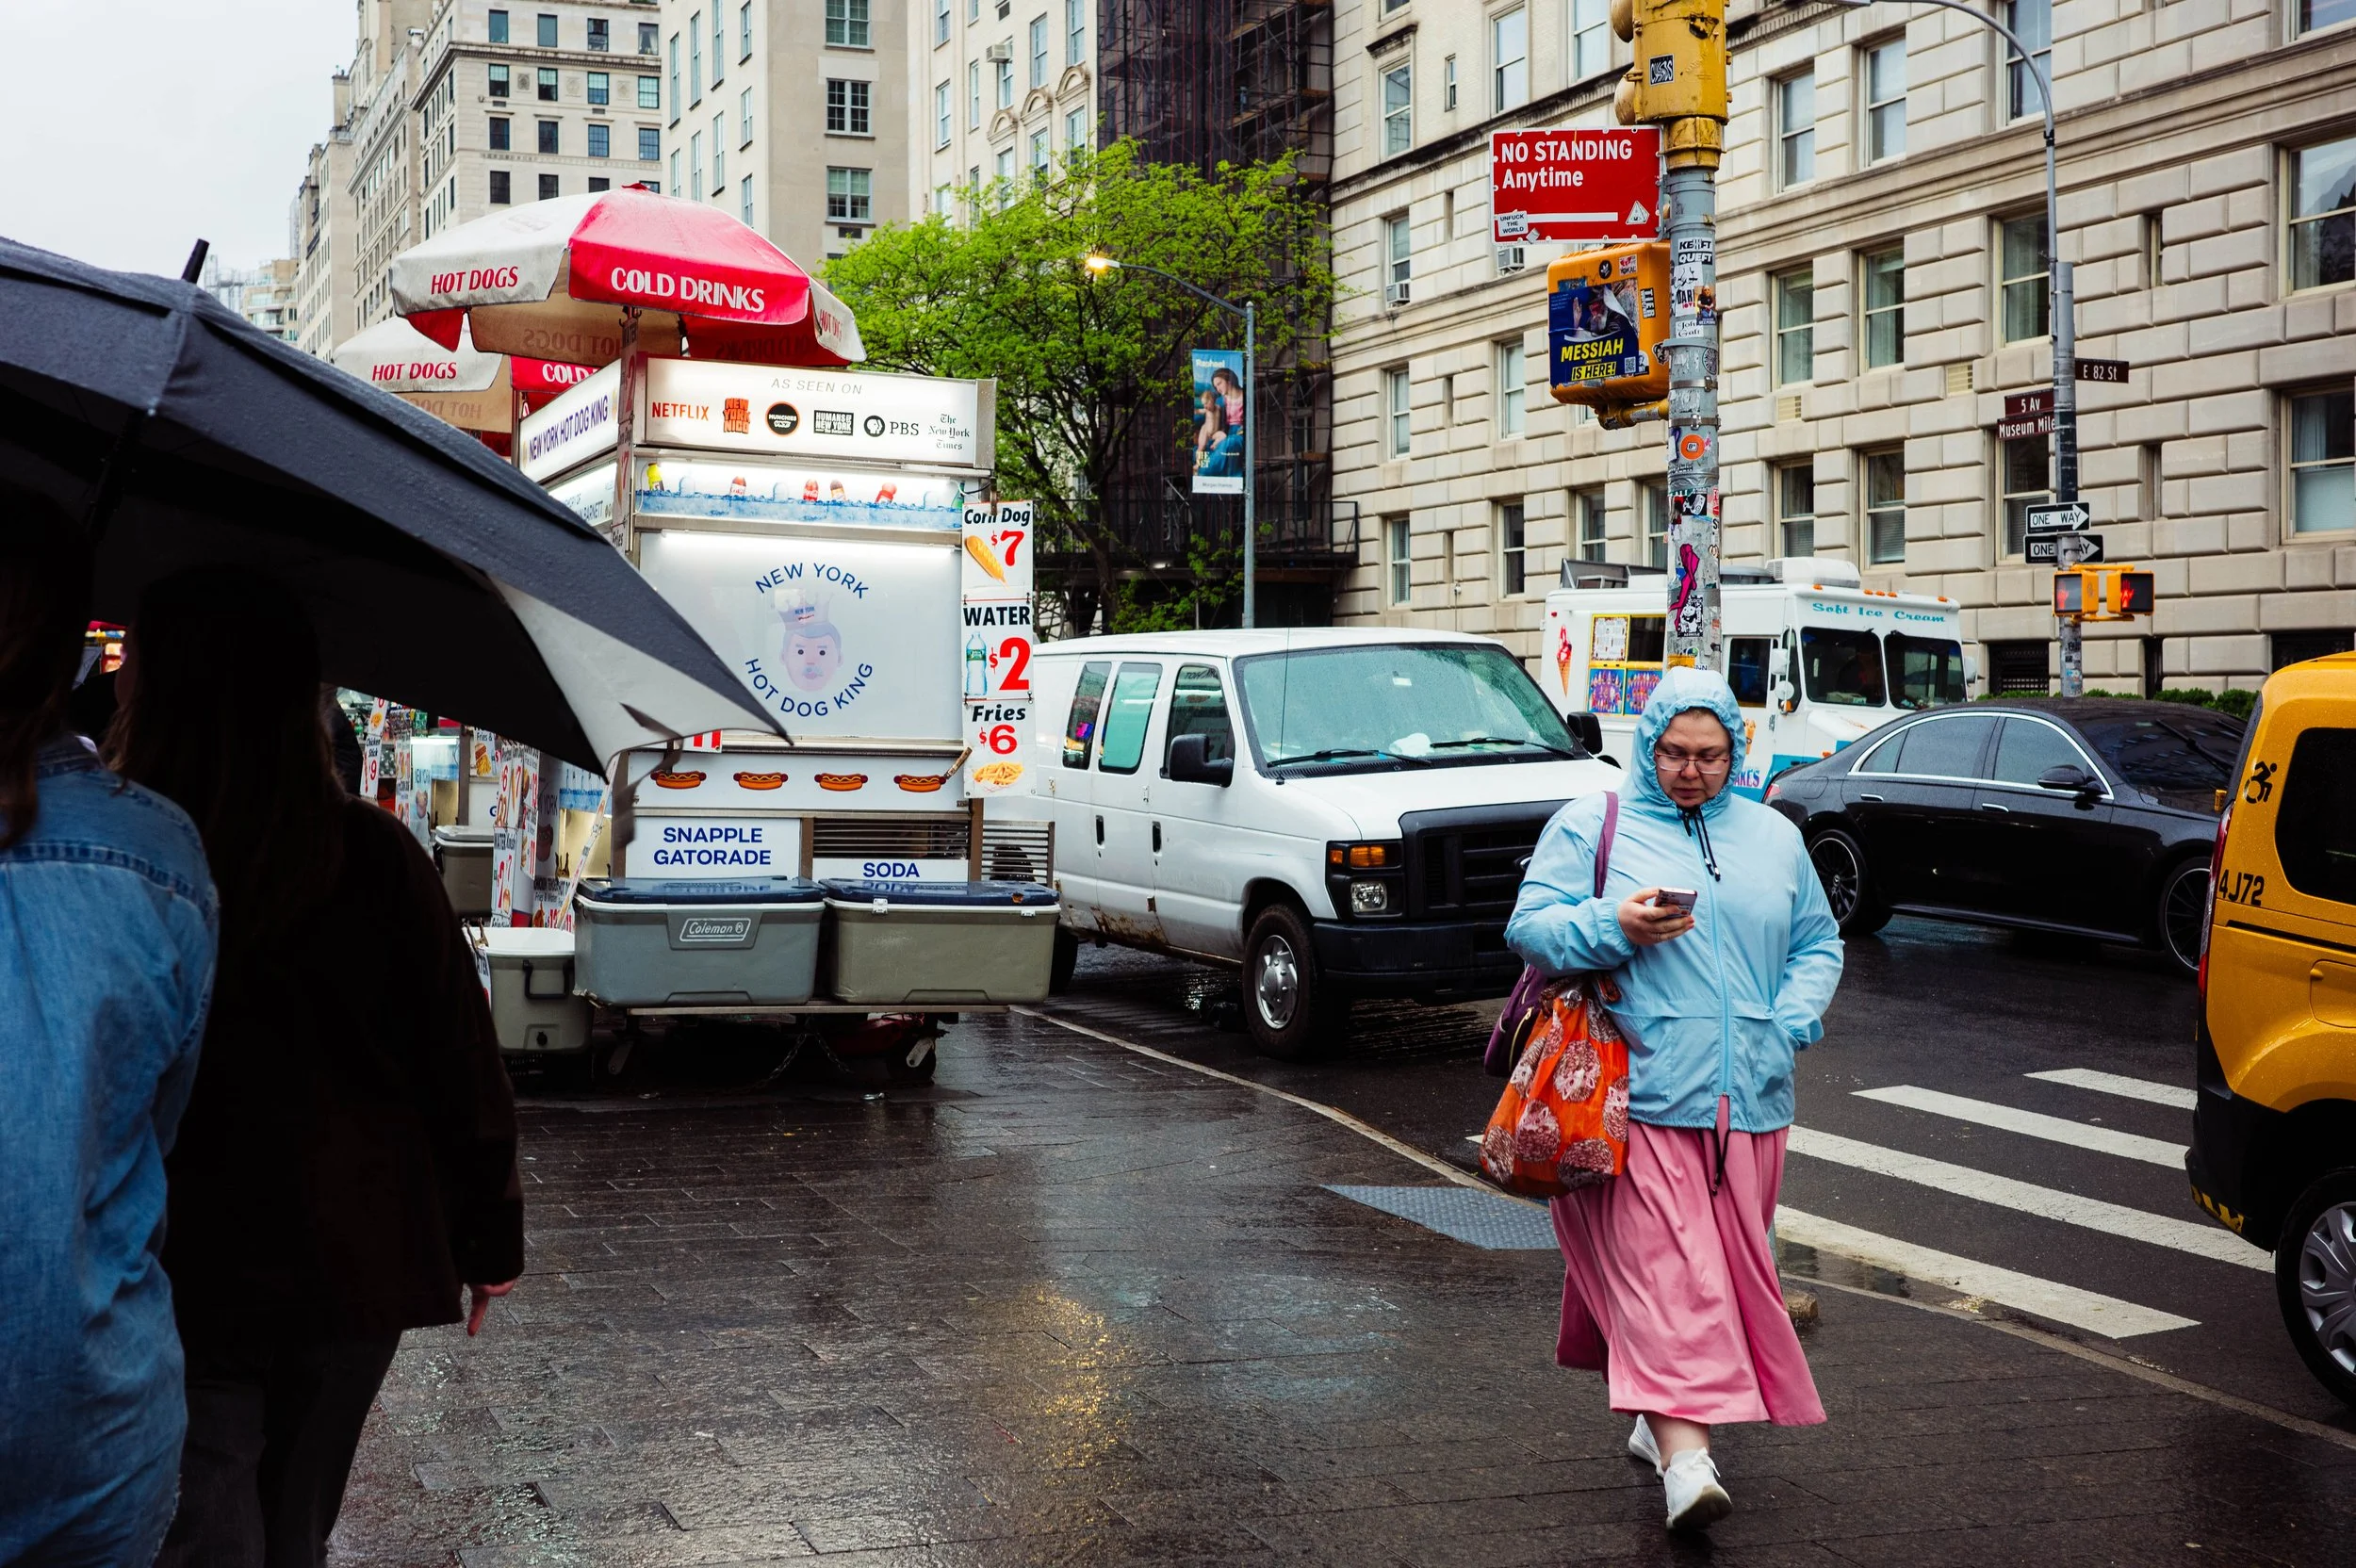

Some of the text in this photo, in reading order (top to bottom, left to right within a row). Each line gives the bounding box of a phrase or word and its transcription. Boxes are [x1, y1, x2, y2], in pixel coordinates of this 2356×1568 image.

[1501, 139, 1632, 163] NO STANDING
[1502, 167, 1584, 192] Anytime
[1499, 213, 1525, 222] UNFUCK
[431, 266, 518, 295] HOT DOGS
[611, 267, 765, 313] COLD DRINKS
[820, 309, 832, 333] HOT
[1681, 321, 1696, 330] Joh
[1561, 338, 1624, 363] MESSIAH
[371, 361, 457, 382] HOT DOGS
[542, 364, 591, 384] COLD
[1572, 362, 1616, 380] IS HERE!
[2083, 365, 2118, 381] E 82 St
[771, 378, 862, 395] AS SEEN ON
[651, 401, 710, 421] NETFLIX
[725, 398, 749, 410] NEW
[2021, 397, 2040, 414] 5 Av
[723, 409, 750, 421] YORK
[816, 412, 845, 422] HUMANS
[940, 413, 957, 424] The
[529, 394, 609, 462] NEW YORK HOT DOG KING
[724, 420, 749, 433] NICO
[815, 420, 852, 432] NEW YORK
[890, 421, 919, 436] PBS
[928, 425, 970, 439] New York
[1999, 416, 2055, 438] Museum Mile
[936, 439, 963, 450] Times
[963, 507, 1031, 527] Corn Dog
[2032, 511, 2081, 526] ONE WAY
[990, 529, 1024, 567] $7
[2033, 544, 2054, 556] ONE
[755, 563, 869, 599] NEW YORK
[962, 605, 1031, 627] WATER
[1812, 602, 1946, 623] Soft Ice Cream
[989, 636, 1031, 691] $2
[744, 658, 873, 717] HOT DOG KING
[972, 704, 1026, 723] Fries
[978, 724, 1018, 755] $6
[1735, 768, 1760, 788] AKES
[663, 826, 763, 843] SNAPPLE
[653, 849, 772, 866] GATORADE
[862, 862, 921, 878] SODA
[2218, 869, 2265, 906] 4J72
[689, 922, 733, 934] Coleman
